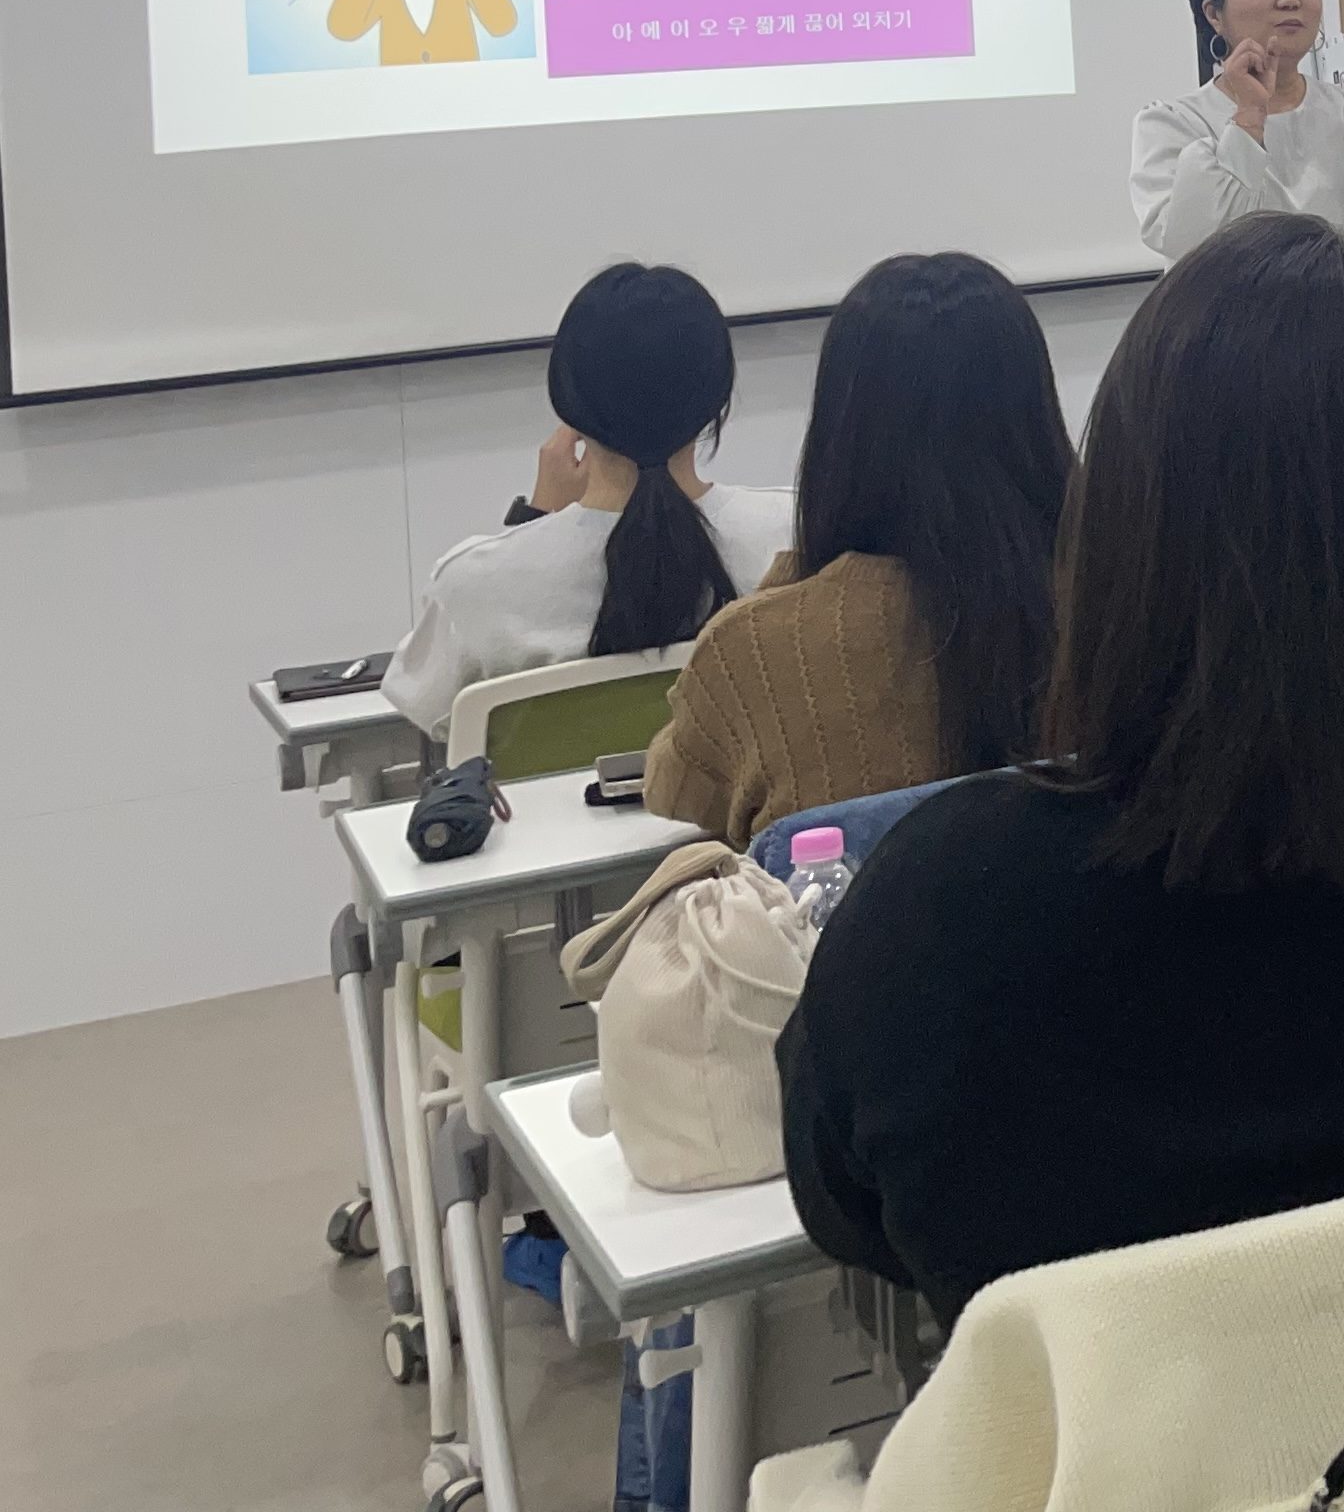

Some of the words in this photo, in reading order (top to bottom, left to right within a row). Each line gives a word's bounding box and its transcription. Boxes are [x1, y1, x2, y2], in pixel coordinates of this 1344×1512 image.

[612, 22, 634, 43] 아
[640, 20, 661, 41] 에
[670, 18, 690, 39] 이
[698, 19, 720, 39] 오
[727, 17, 749, 39] 우
[803, 10, 844, 33] 끊어
[851, 8, 913, 32] 외치기
